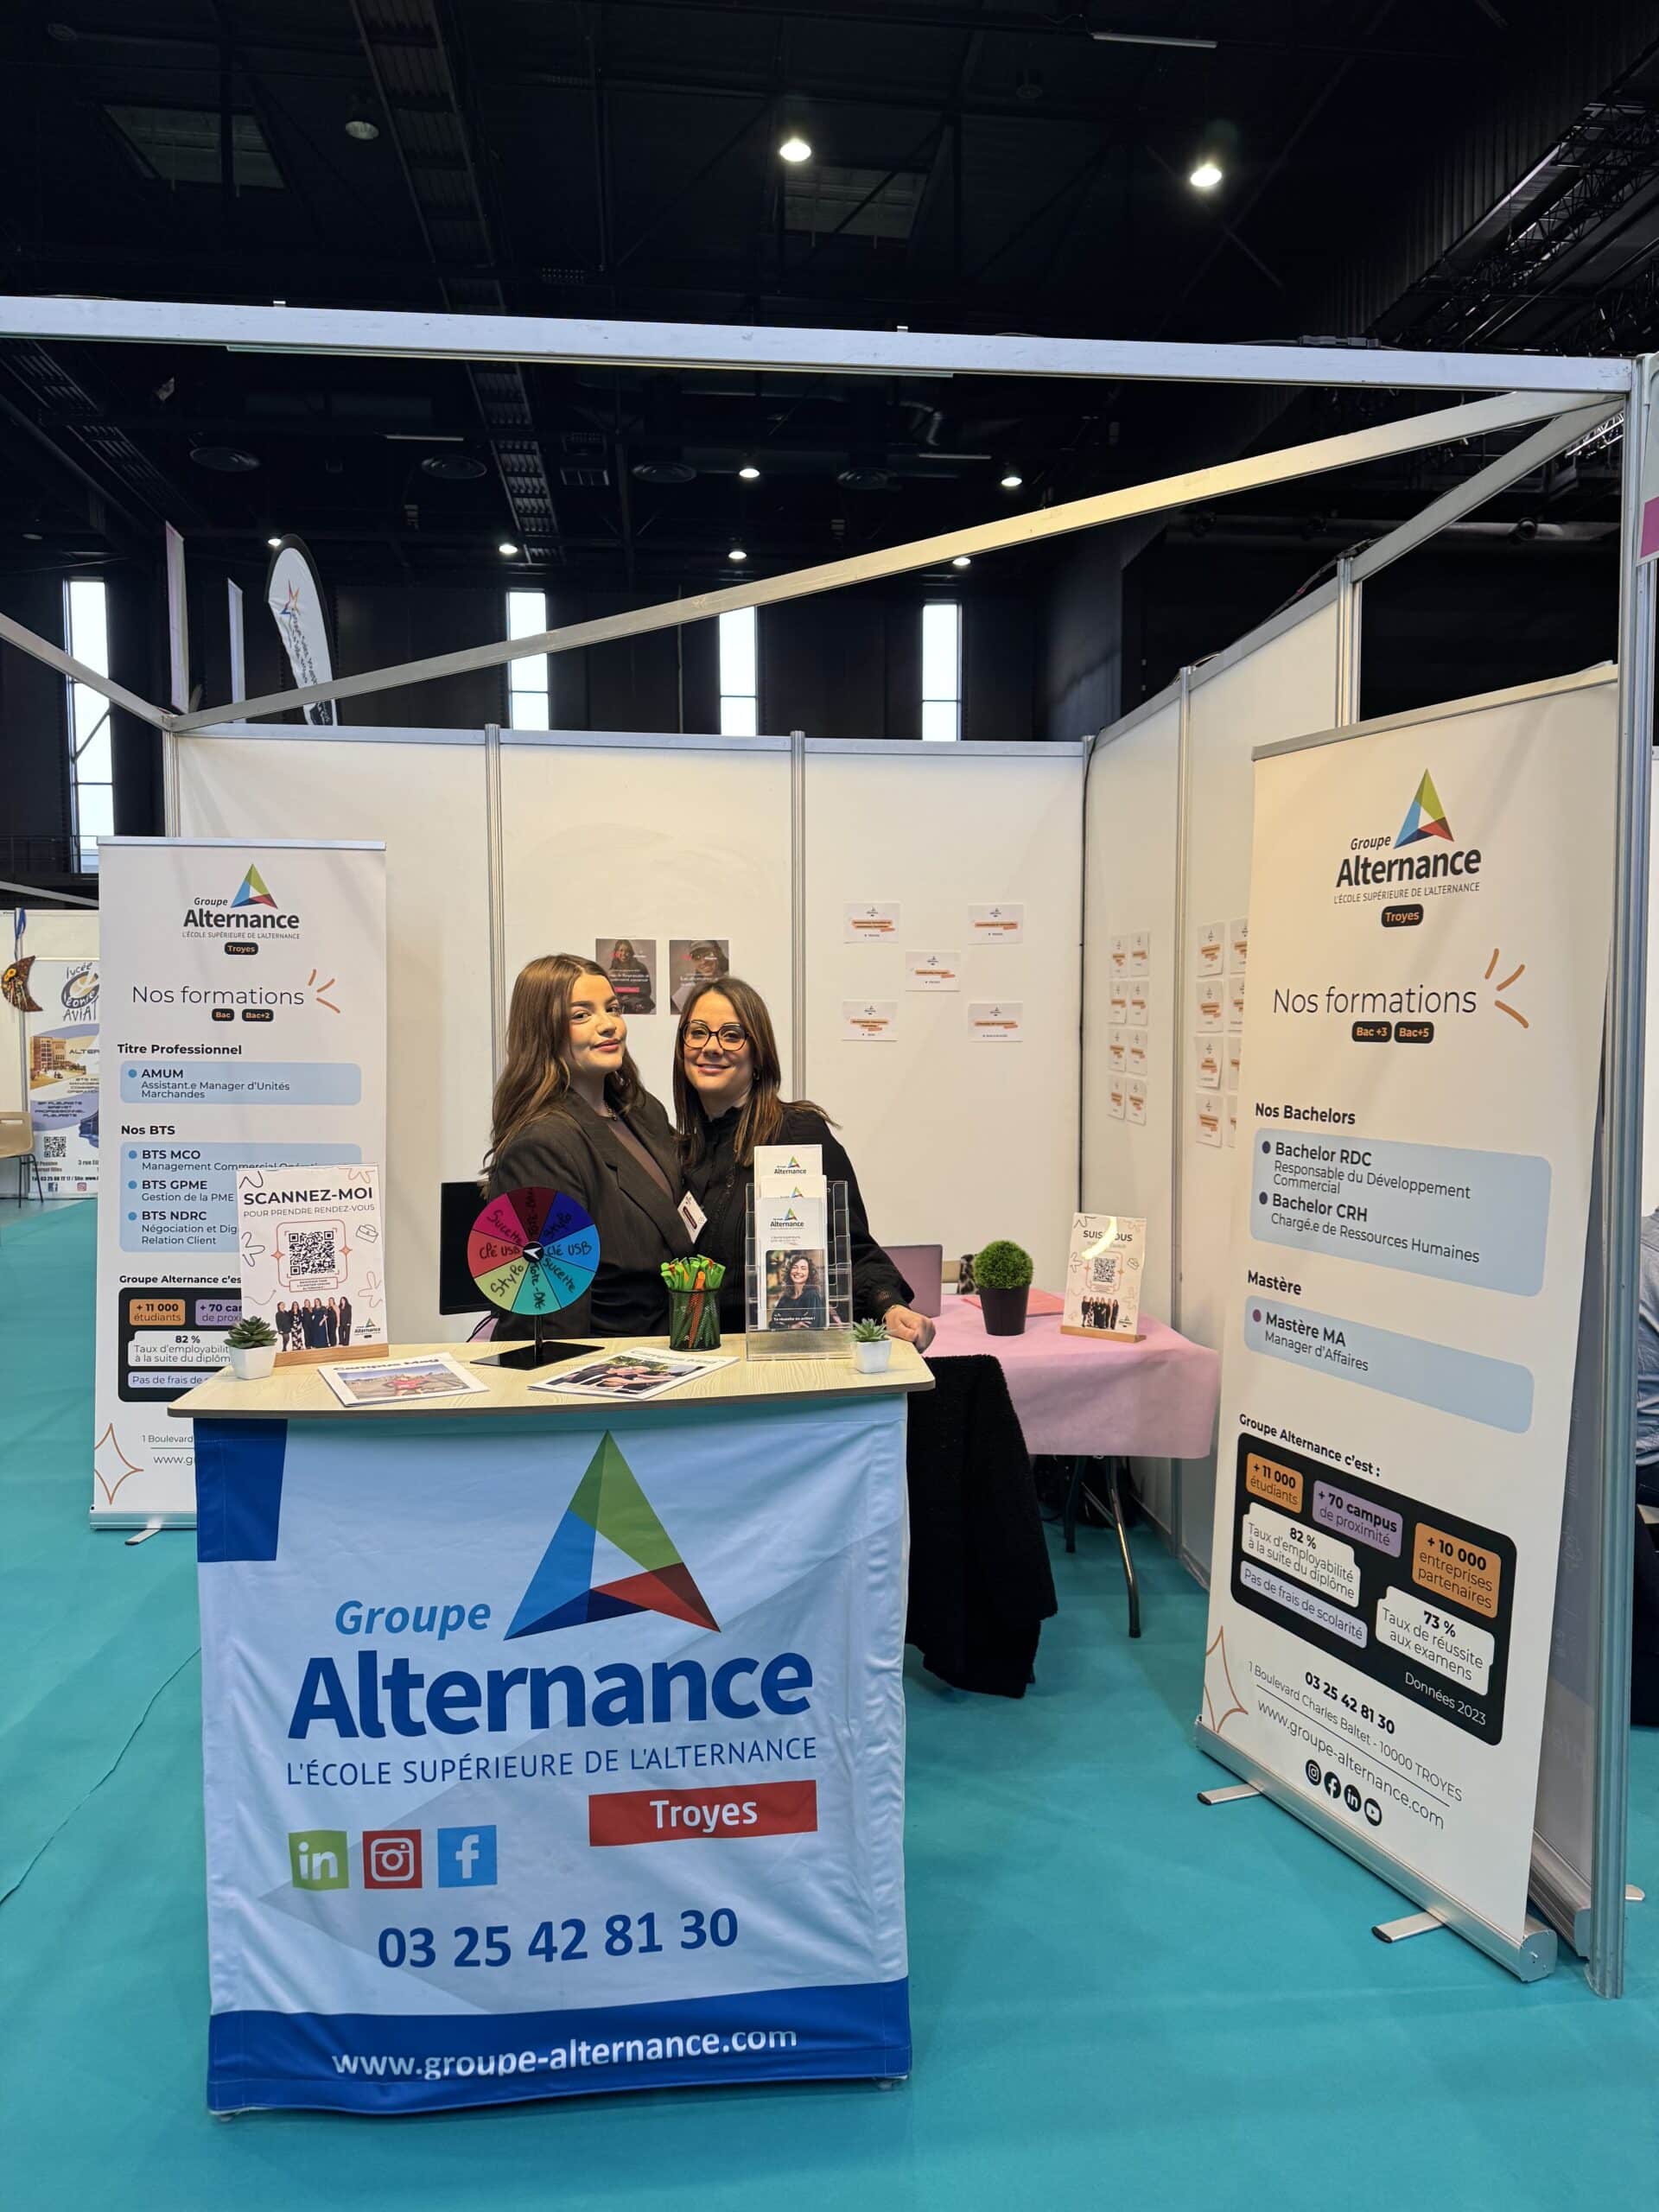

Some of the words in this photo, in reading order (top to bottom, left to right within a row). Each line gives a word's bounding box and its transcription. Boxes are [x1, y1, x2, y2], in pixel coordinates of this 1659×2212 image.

[1351, 836, 1391, 851] Groupe
[1336, 849, 1481, 887] Alternance
[194, 897, 228, 907] Groupe
[1363, 889, 1409, 902] SUPÉRIEURE
[1411, 887, 1422, 898] DE
[183, 909, 300, 929] Alternance
[1385, 910, 1420, 924] Troyes
[227, 945, 256, 954] Troyes
[132, 986, 175, 1004] Nos
[181, 986, 304, 1005] formations
[1273, 988, 1319, 1014] Nos
[1326, 985, 1478, 1014] formations
[1399, 1027, 1429, 1038] Bac+5
[118, 1044, 147, 1054] Titre
[151, 1044, 242, 1055] Professionnel
[141, 1069, 184, 1078] AMUM
[141, 1081, 197, 1090] Assistant.e
[200, 1082, 245, 1092] Manager
[247, 1082, 290, 1090] d'Unités
[142, 1090, 206, 1099] Marchandes
[1255, 1103, 1280, 1118] Nos
[1283, 1105, 1356, 1125] Bachelors
[121, 1126, 146, 1135] Nos
[149, 1126, 175, 1135] BTS
[142, 1150, 167, 1160] BTS
[170, 1150, 201, 1160] MCO
[1275, 1141, 1336, 1162] Bachelor
[1339, 1150, 1372, 1166] RDC
[142, 1162, 211, 1172] Management
[1274, 1160, 1344, 1181] Responsable
[1347, 1170, 1363, 1183] du
[1367, 1172, 1471, 1199] Développement
[142, 1180, 167, 1190] BTS
[170, 1180, 208, 1190] GPME
[244, 1187, 372, 1205] SCANNEZ-MOI
[1273, 1174, 1340, 1194] Commercial
[142, 1193, 181, 1202] Gestion
[183, 1193, 196, 1202] de
[200, 1193, 208, 1202] la
[211, 1193, 234, 1202] PME
[1272, 1193, 1333, 1216] Bachelor
[1336, 1206, 1368, 1223] CRH
[142, 1211, 167, 1220] BTS
[170, 1211, 207, 1220] NDRC
[271, 1207, 312, 1217] PRENDRE
[315, 1204, 375, 1214] RENDEZ-VOUS
[142, 1224, 204, 1235] Négociation
[1271, 1212, 1320, 1232] Chargé.e
[1322, 1221, 1337, 1236] de
[1339, 1224, 1408, 1249] Ressources
[1411, 1238, 1480, 1263] Humaines
[119, 1275, 158, 1284] Groupe
[1247, 1270, 1301, 1295] Mastère
[134, 1313, 181, 1321] étudiants
[1265, 1312, 1319, 1338] Mastère
[1323, 1326, 1346, 1347] MA
[154, 1354, 178, 1363] suite
[181, 1354, 194, 1363] du
[1265, 1330, 1313, 1355] Manager
[1314, 1344, 1369, 1372] d'Affaires
[168, 1376, 188, 1384] frais
[190, 1376, 202, 1384] de
[1239, 1414, 1277, 1437] Groupe
[1279, 1427, 1342, 1462] Alternance
[1344, 1453, 1374, 1475] c'est
[1250, 1476, 1298, 1505] étudiants
[1274, 1470, 1296, 1489] 000
[1328, 1491, 1344, 1509] 70
[1346, 1500, 1397, 1532] campus
[1290, 1527, 1304, 1543] 82
[1319, 1506, 1334, 1521] de
[1336, 1516, 1390, 1547] proximité
[1248, 1522, 1272, 1544] Taux
[1273, 1532, 1354, 1582] d'employabilité
[1439, 1539, 1454, 1558] 10
[1457, 1548, 1487, 1572] 000
[1266, 1546, 1292, 1568] suite
[1293, 1560, 1307, 1575] du
[1309, 1568, 1355, 1599] diplôme
[1420, 1551, 1493, 1593] entreprises
[1418, 1567, 1492, 1610] partenaires
[1244, 1567, 1262, 1587] Pas
[1263, 1578, 1277, 1592] de
[1278, 1584, 1300, 1606] frais
[1301, 1597, 1316, 1615] de
[1316, 1606, 1363, 1640] scolarité
[335, 1599, 492, 1640] Groupe
[1424, 1611, 1440, 1630] 73
[1444, 1621, 1456, 1638] %
[1382, 1607, 1409, 1631] Taux
[1413, 1624, 1429, 1640] de
[1433, 1630, 1484, 1669] réussite
[1389, 1631, 1412, 1648] aux
[1414, 1642, 1472, 1681] examens
[288, 1649, 813, 1740] Alternance
[1305, 1671, 1321, 1689] 03
[1323, 1681, 1338, 1700] 25
[1341, 1692, 1358, 1711] 42
[1360, 1702, 1375, 1723] 81
[1377, 1713, 1395, 1735] 30
[1405, 1672, 1455, 1710] Données
[1458, 1700, 1486, 1726] 2023
[1255, 1662, 1300, 1702] Boulevard
[1302, 1692, 1338, 1726] Charles
[1341, 1716, 1371, 1745] Baltet
[1380, 1740, 1413, 1770] 10000
[1415, 1760, 1463, 1802] TROYES
[287, 1757, 391, 1787] L'ÉCOLE
[403, 1748, 574, 1783] SUPÉRIEURE
[586, 1750, 619, 1773] DE
[630, 1738, 817, 1771] L'ALTERNANCE
[1258, 1699, 1445, 1830] www.groupe-alternance.com
[650, 1799, 759, 1834] Troyes
[378, 1927, 436, 1969] 03
[454, 1925, 511, 1967] 25
[528, 1919, 588, 1962] 42
[605, 1912, 663, 1955] 81
[680, 1907, 739, 1950] 30
[332, 2029, 798, 2080] www.groupe-alternance.com
